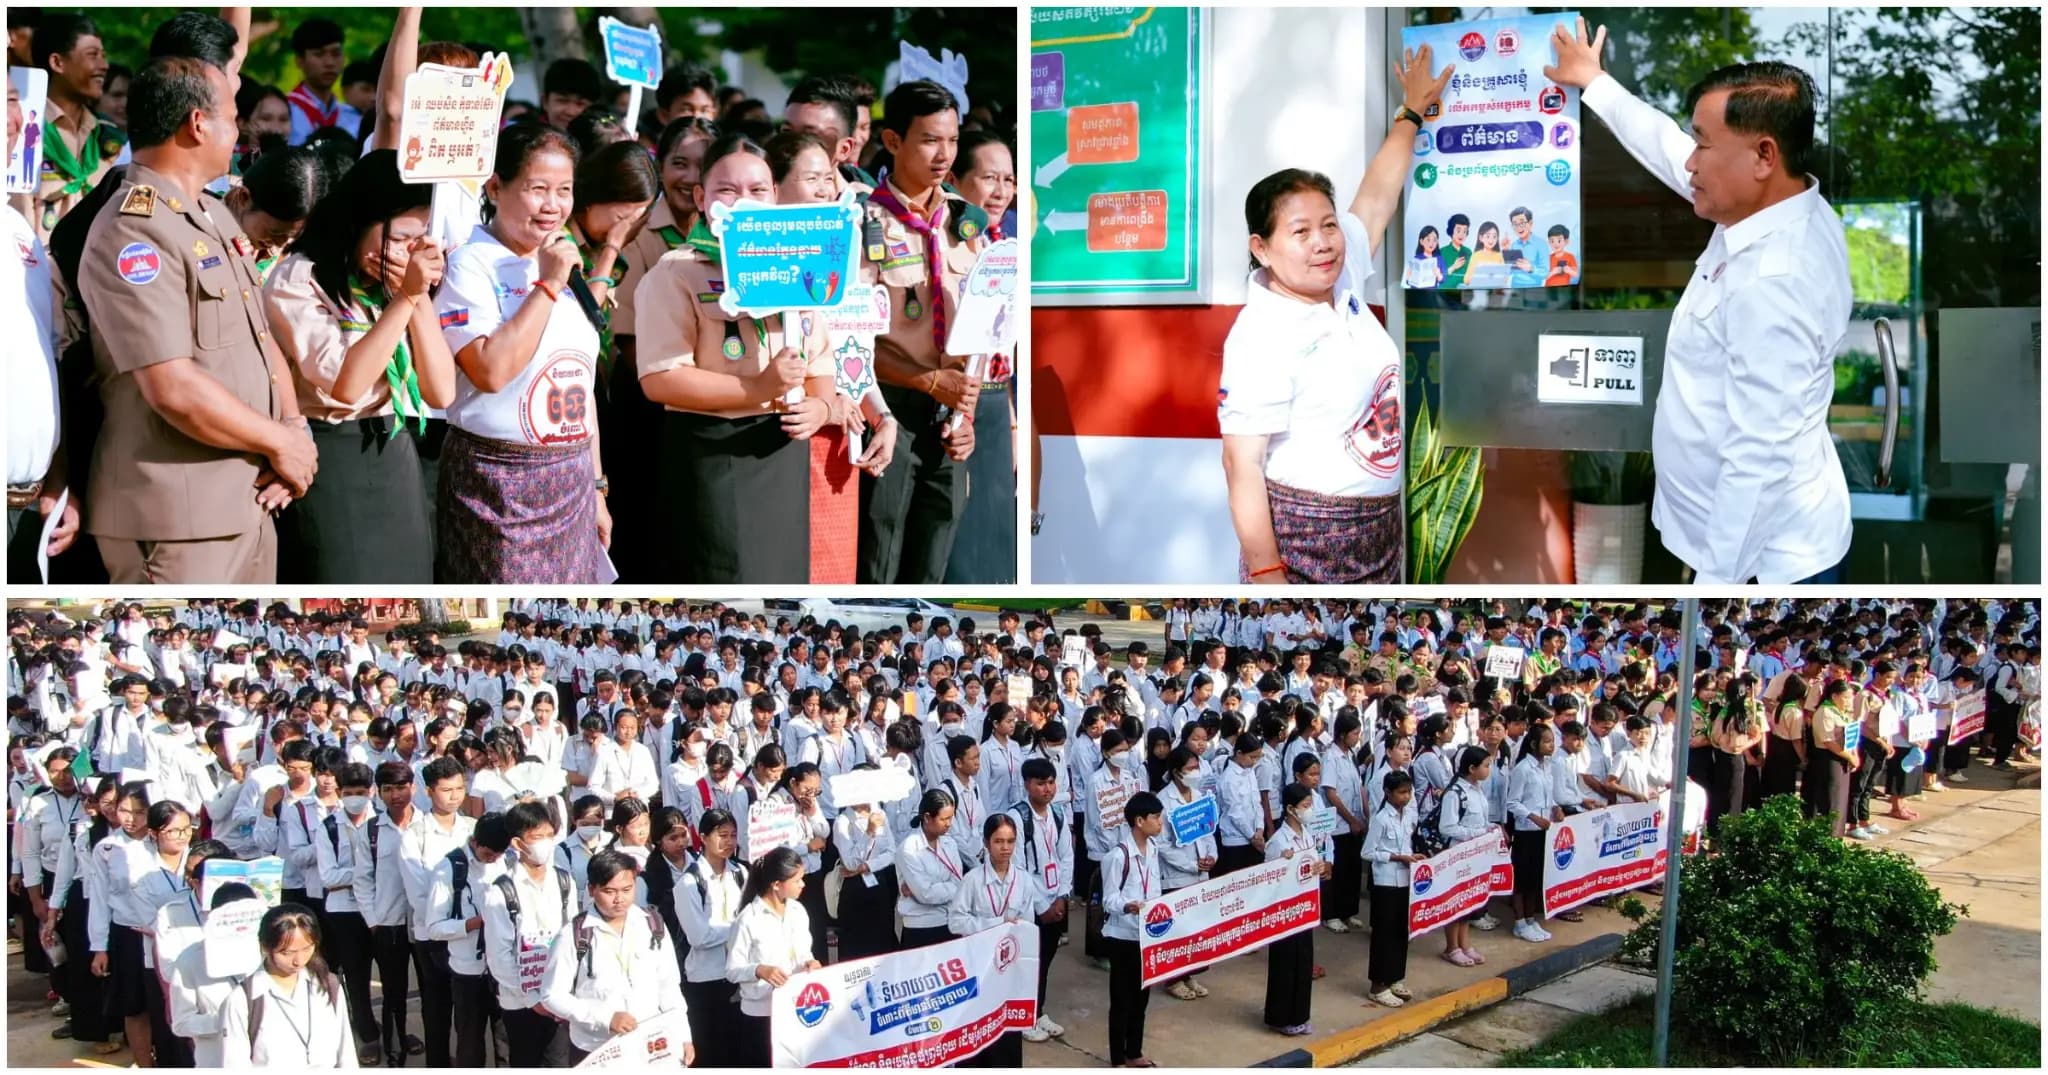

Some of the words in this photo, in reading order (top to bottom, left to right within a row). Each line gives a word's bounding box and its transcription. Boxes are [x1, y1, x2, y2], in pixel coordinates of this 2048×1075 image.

[1461, 126, 1520, 147] ព័ត៌មាន
[1594, 348, 1636, 369] ទាញ
[1593, 378, 1636, 391] PULL
